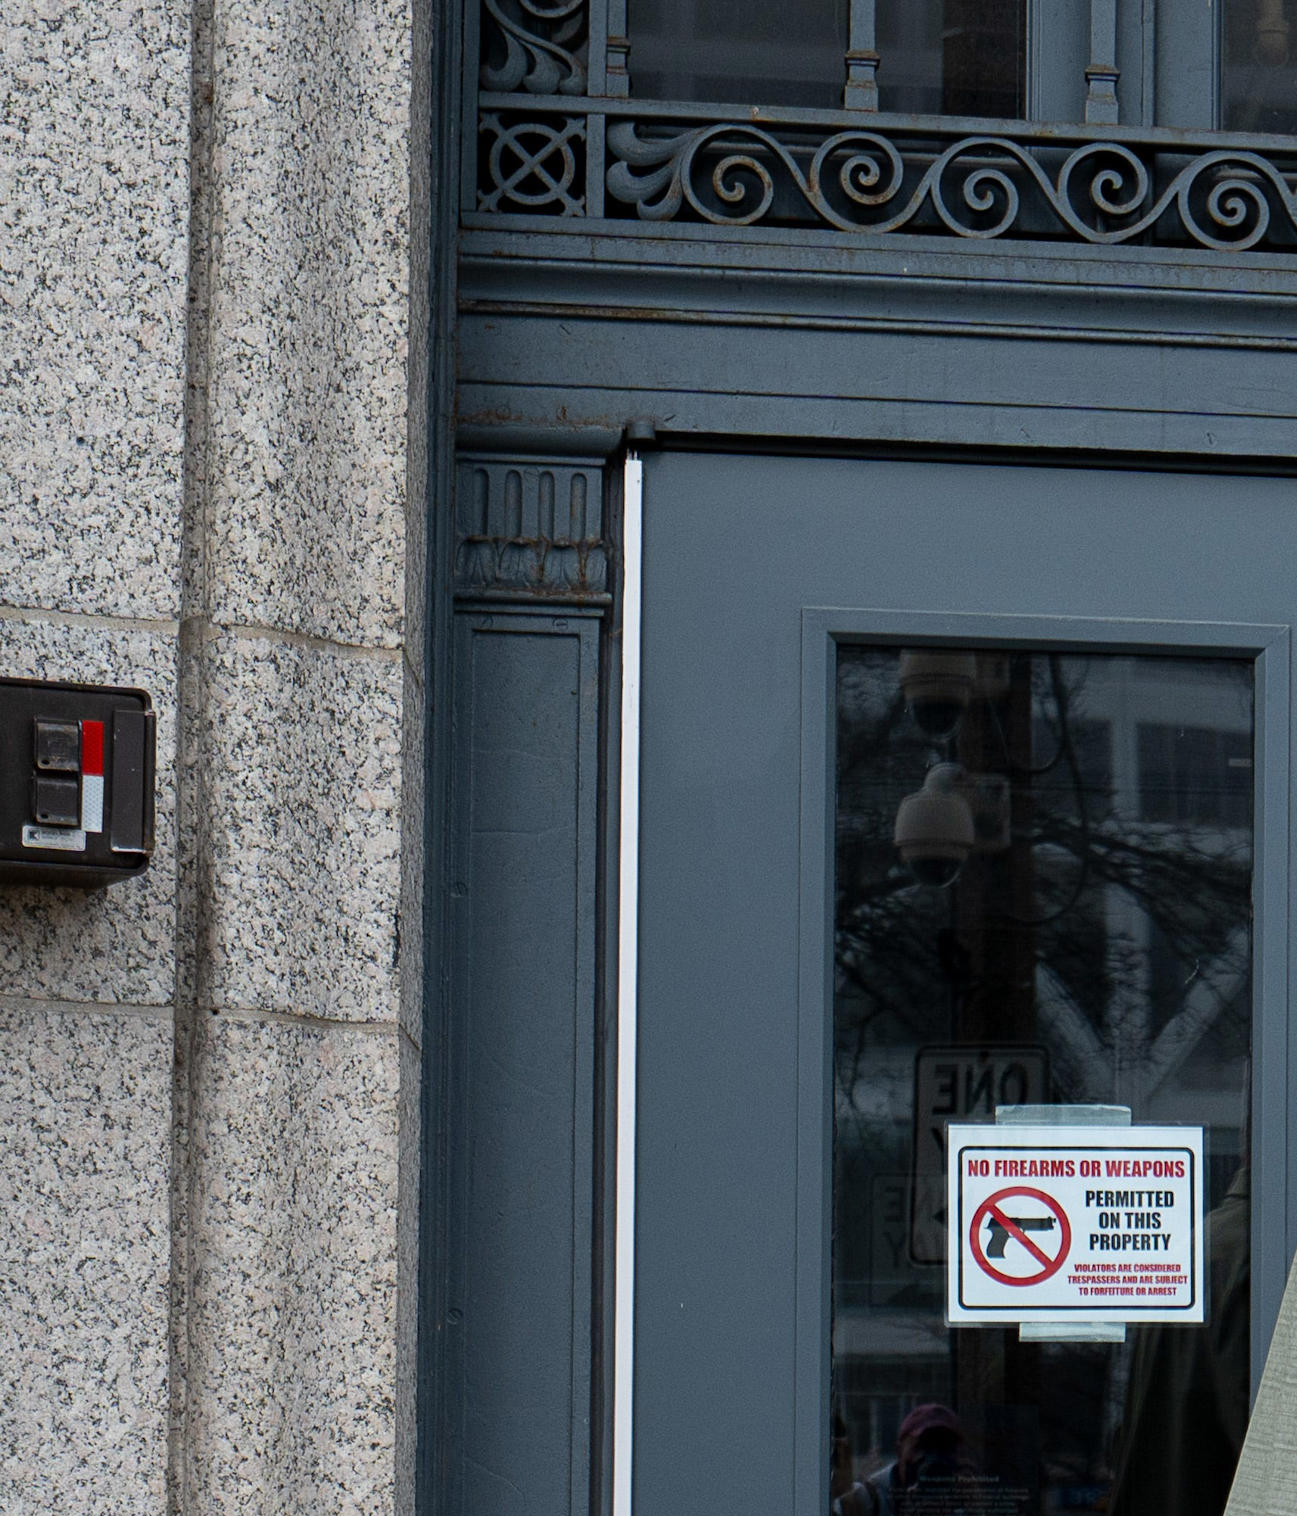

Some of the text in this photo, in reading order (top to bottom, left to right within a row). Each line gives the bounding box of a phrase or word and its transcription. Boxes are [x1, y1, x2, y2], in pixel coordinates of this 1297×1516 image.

[968, 1159, 1185, 1178] NO FIREARMS OR WEAPONS
[1085, 1190, 1175, 1208] PERMITTED
[1099, 1212, 1161, 1230] ON THIS
[1089, 1233, 1171, 1251] PROPERTY
[1074, 1264, 1181, 1273] VIOLATORS ARE CONSIDERED
[1068, 1275, 1188, 1285] TRESPASSERS AND ARE SUBJECT
[1079, 1287, 1177, 1296] TO FORFEITURE OR ARREST
